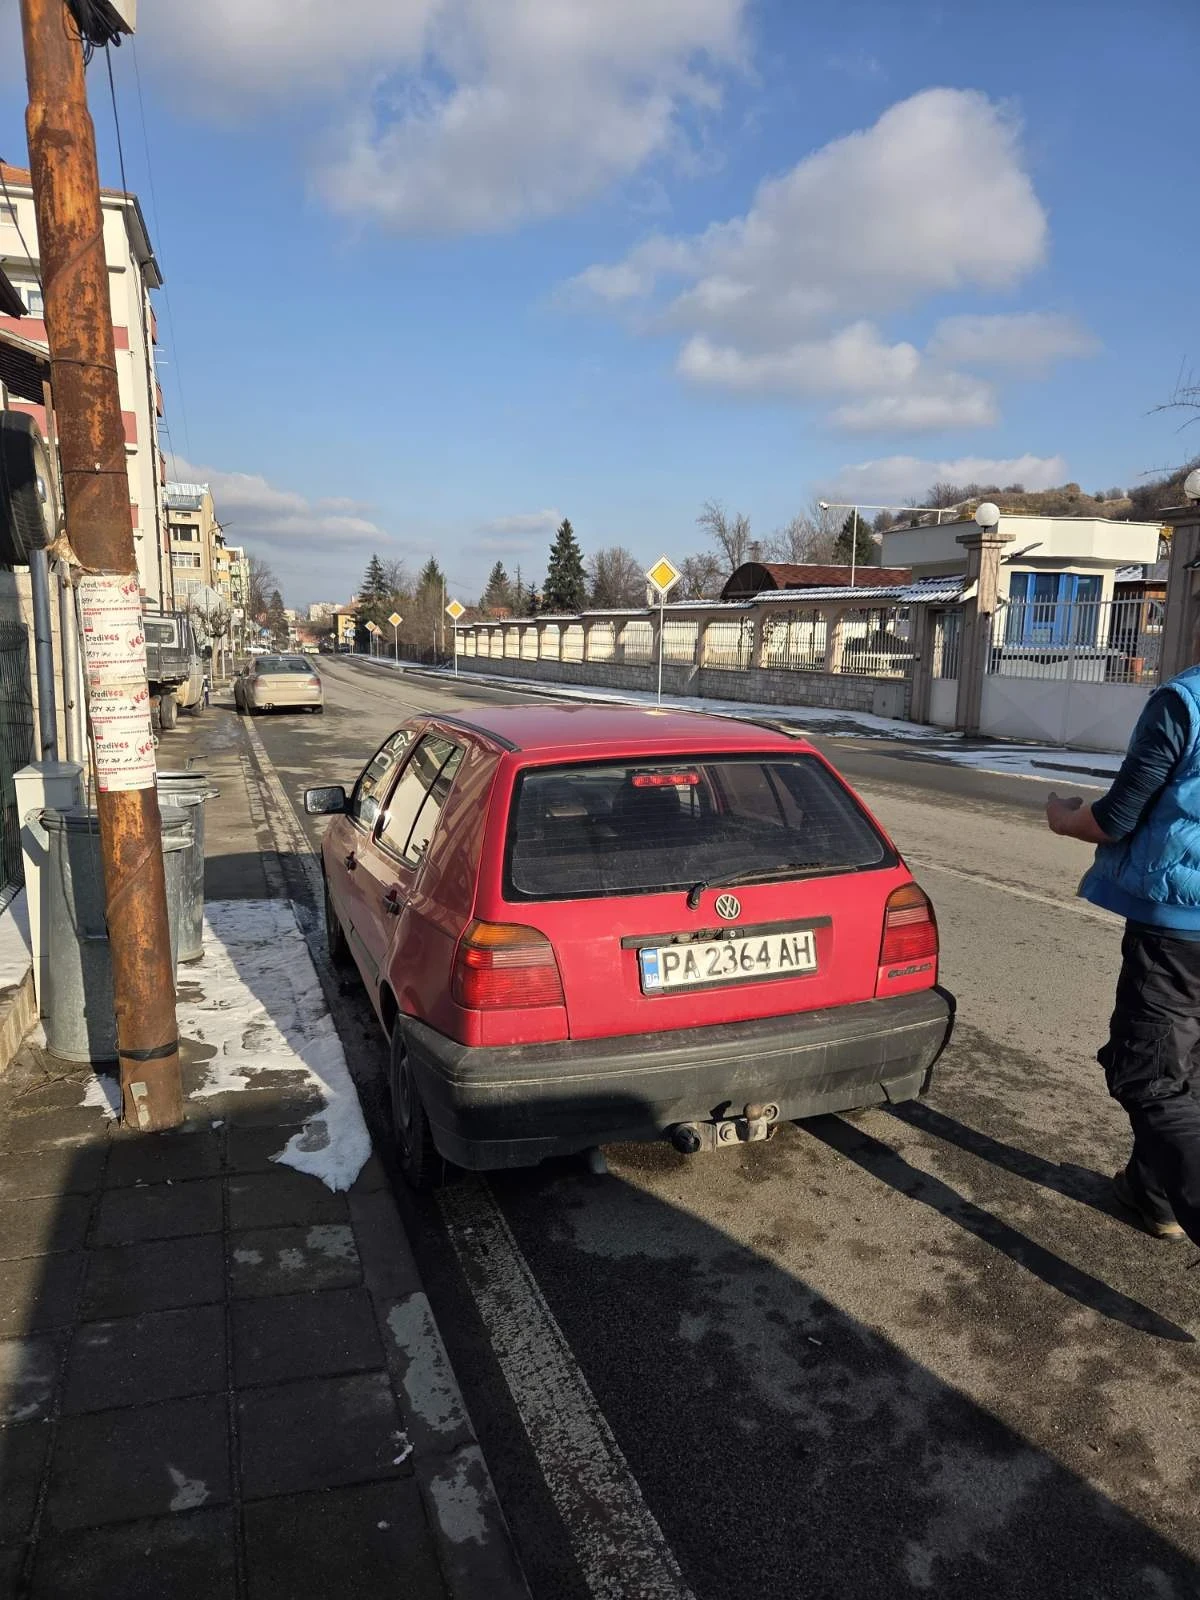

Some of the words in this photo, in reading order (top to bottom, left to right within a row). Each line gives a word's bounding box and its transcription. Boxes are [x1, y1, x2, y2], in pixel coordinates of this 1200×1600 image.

[662, 949, 701, 982] PA
[705, 940, 771, 977] 2364
[778, 935, 812, 968] AH
